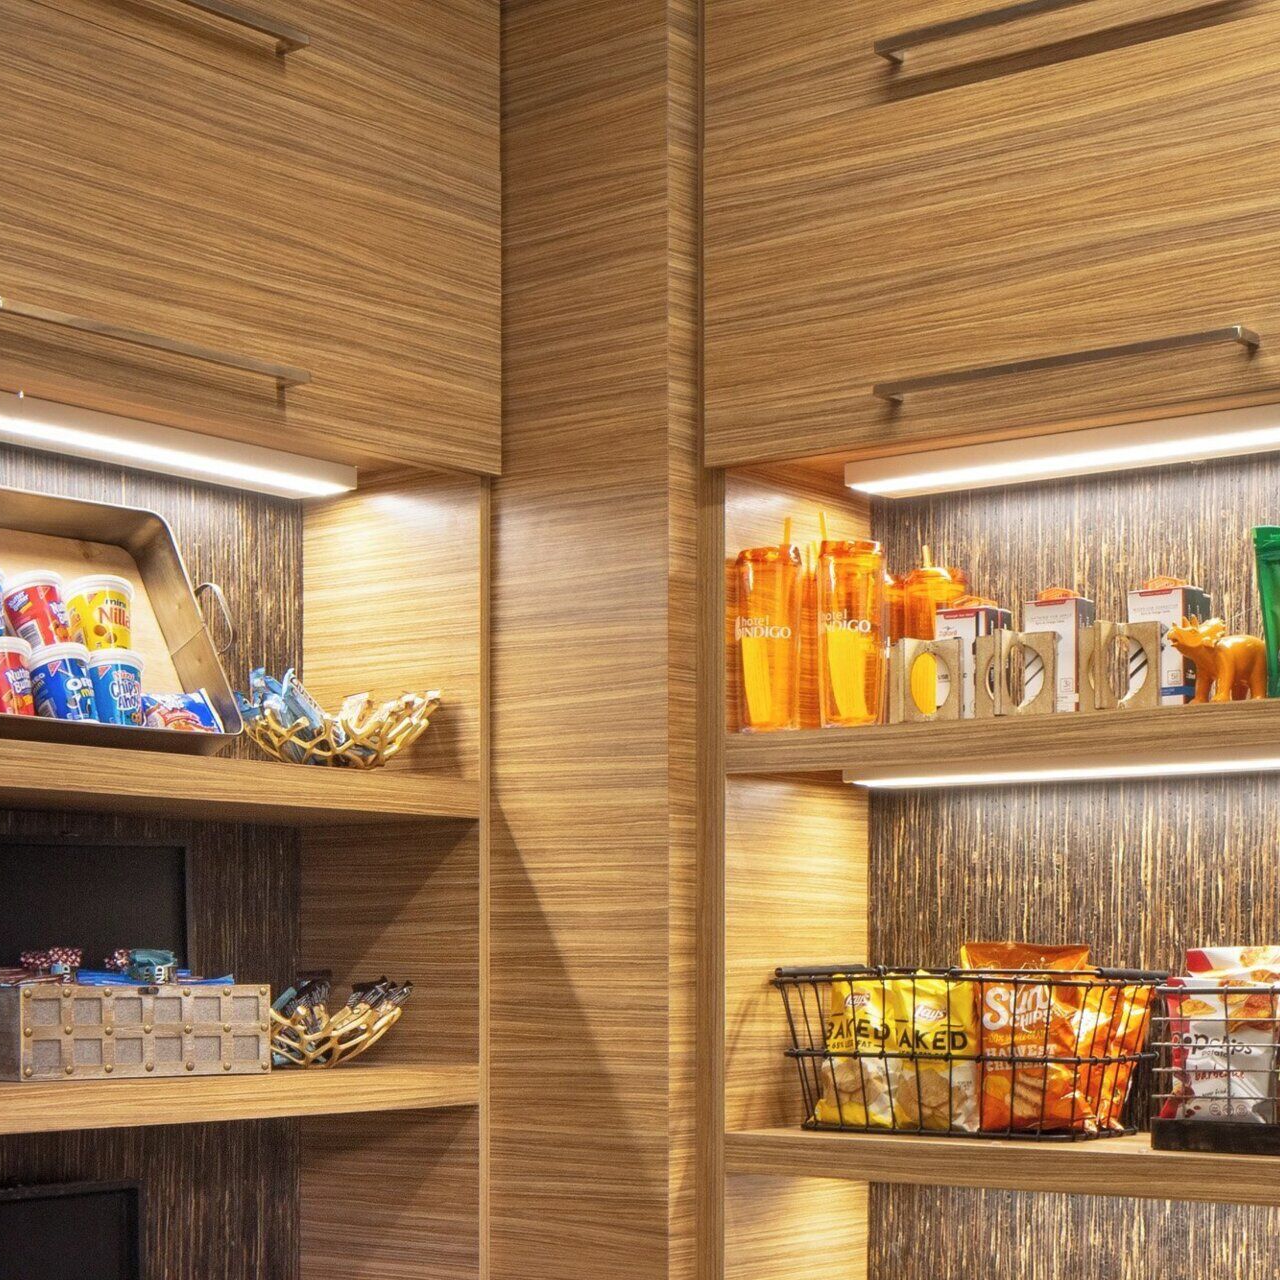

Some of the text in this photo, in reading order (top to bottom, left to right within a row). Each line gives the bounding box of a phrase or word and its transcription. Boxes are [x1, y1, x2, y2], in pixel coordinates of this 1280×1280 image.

[105, 597, 126, 606] mini
[741, 615, 769, 626] hotel
[741, 626, 791, 639] INDIGO
